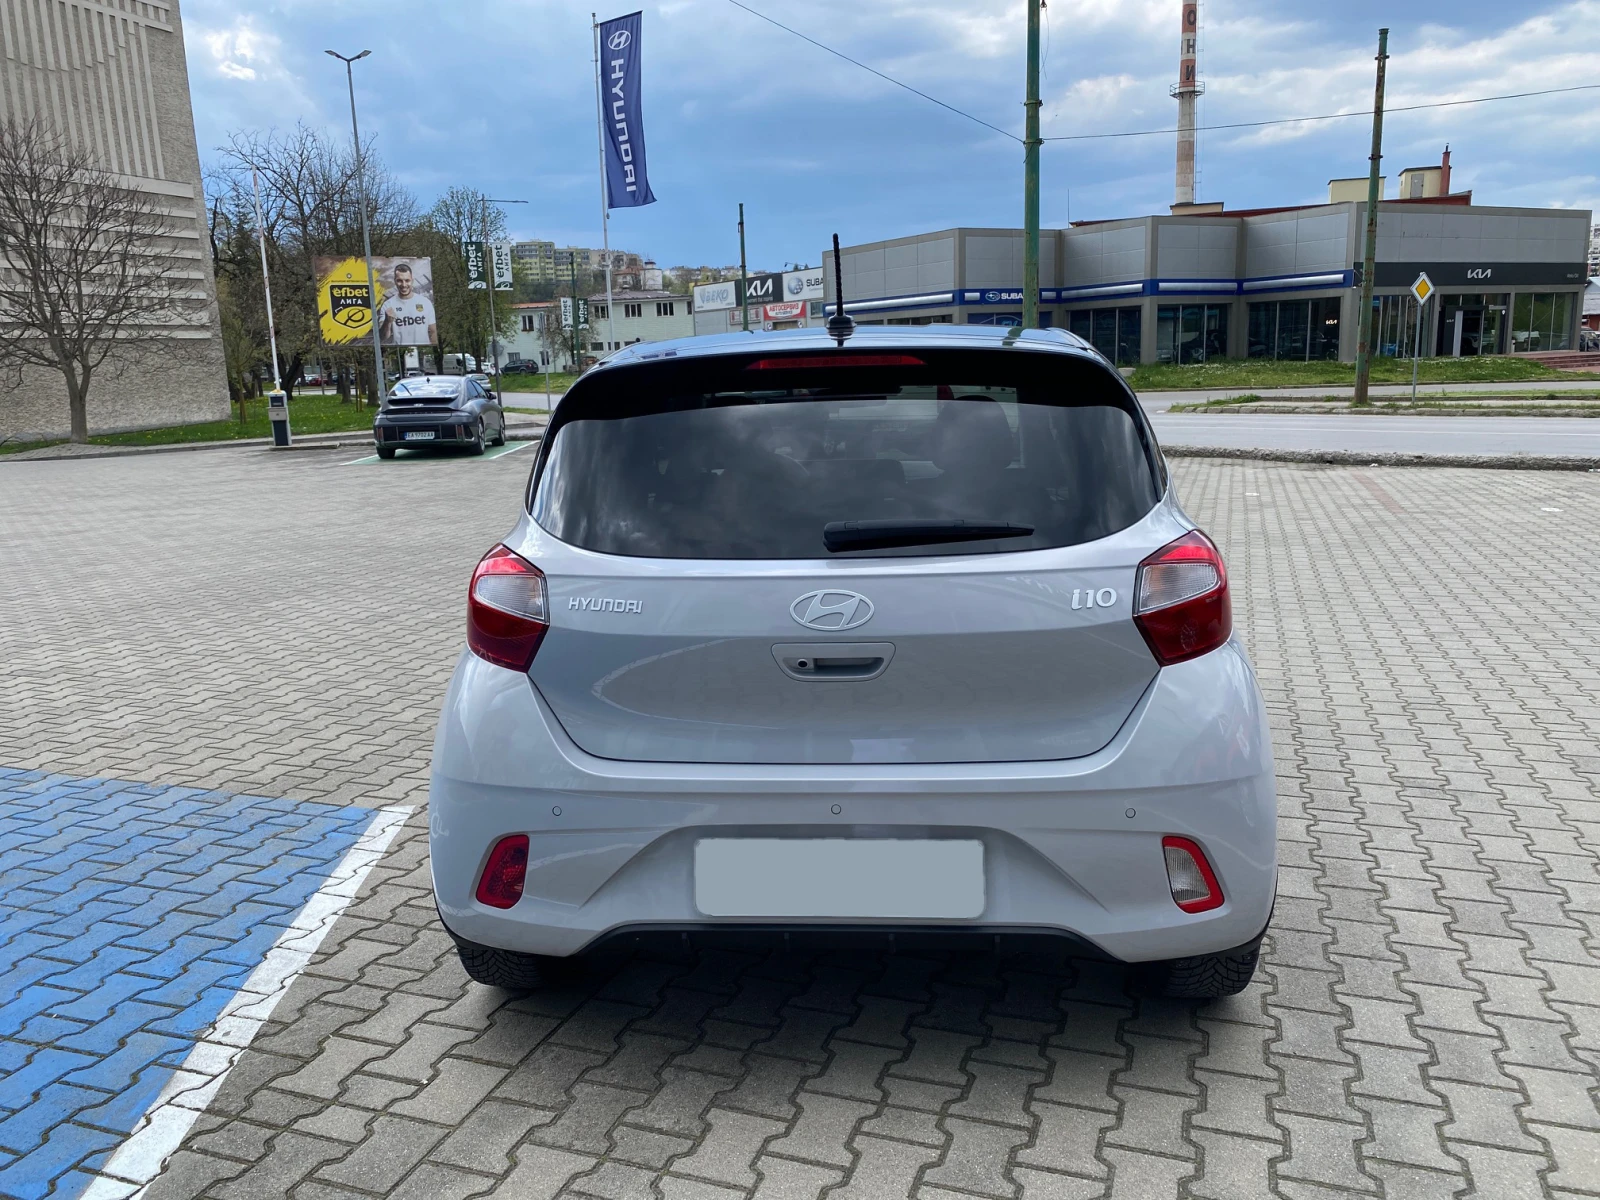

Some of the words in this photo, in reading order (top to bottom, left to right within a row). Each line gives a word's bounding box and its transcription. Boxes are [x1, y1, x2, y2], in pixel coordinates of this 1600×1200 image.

[611, 58, 636, 192] HYUNDAI
[467, 244, 478, 279] efbet
[495, 244, 505, 279] efbet
[1467, 268, 1492, 278] KIA
[746, 278, 773, 297] KIA
[806, 277, 824, 287] SUBA
[332, 287, 369, 297] efbet
[1001, 292, 1023, 300] SUBA
[769, 303, 799, 312] АВТОСЕРВИЗ
[395, 316, 425, 327] efbet
[568, 597, 643, 614] HYUNDAI
[1071, 587, 1117, 610] i10
